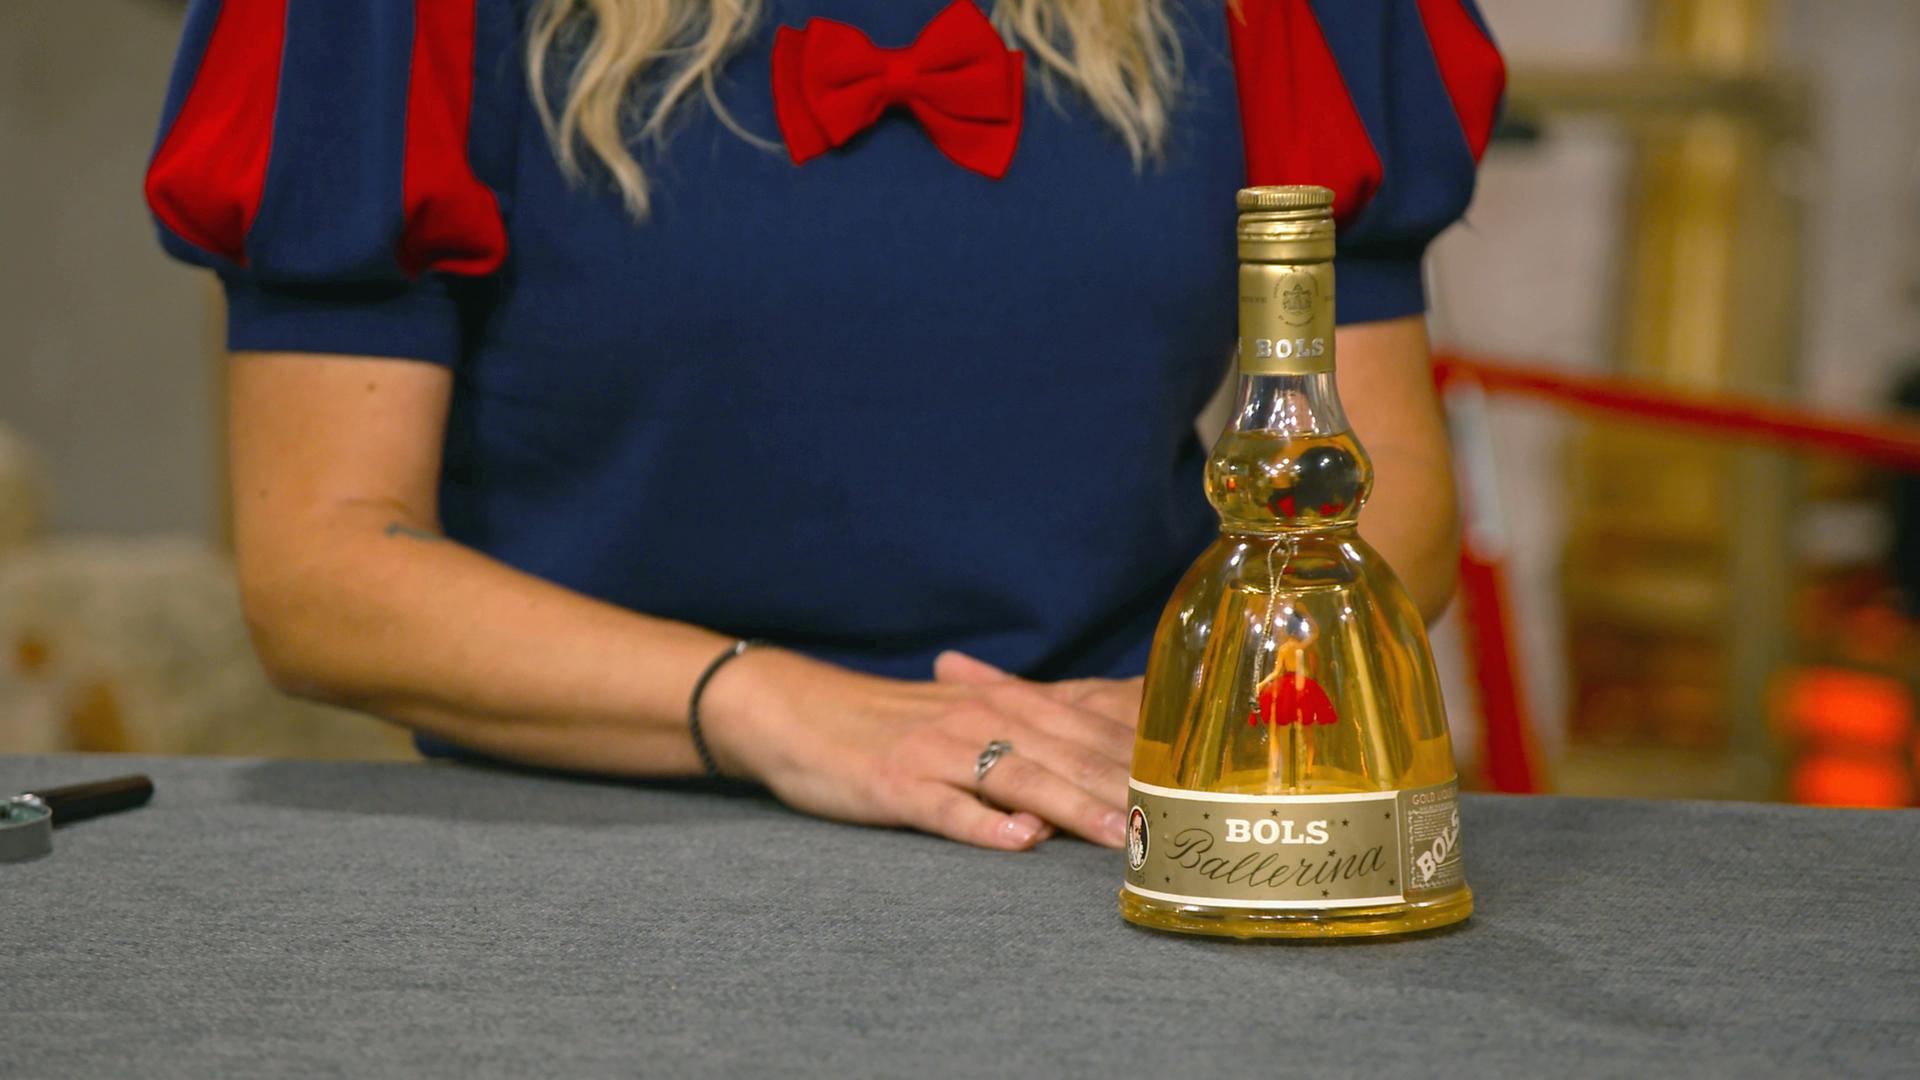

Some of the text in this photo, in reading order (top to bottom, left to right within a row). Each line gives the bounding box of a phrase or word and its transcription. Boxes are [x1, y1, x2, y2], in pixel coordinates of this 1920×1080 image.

[1256, 338, 1324, 359] BOLS
[1412, 791, 1435, 806] GOLD
[1225, 818, 1329, 845] BOLS
[1416, 808, 1460, 882] BOLS
[1164, 828, 1385, 888] Ballerina
